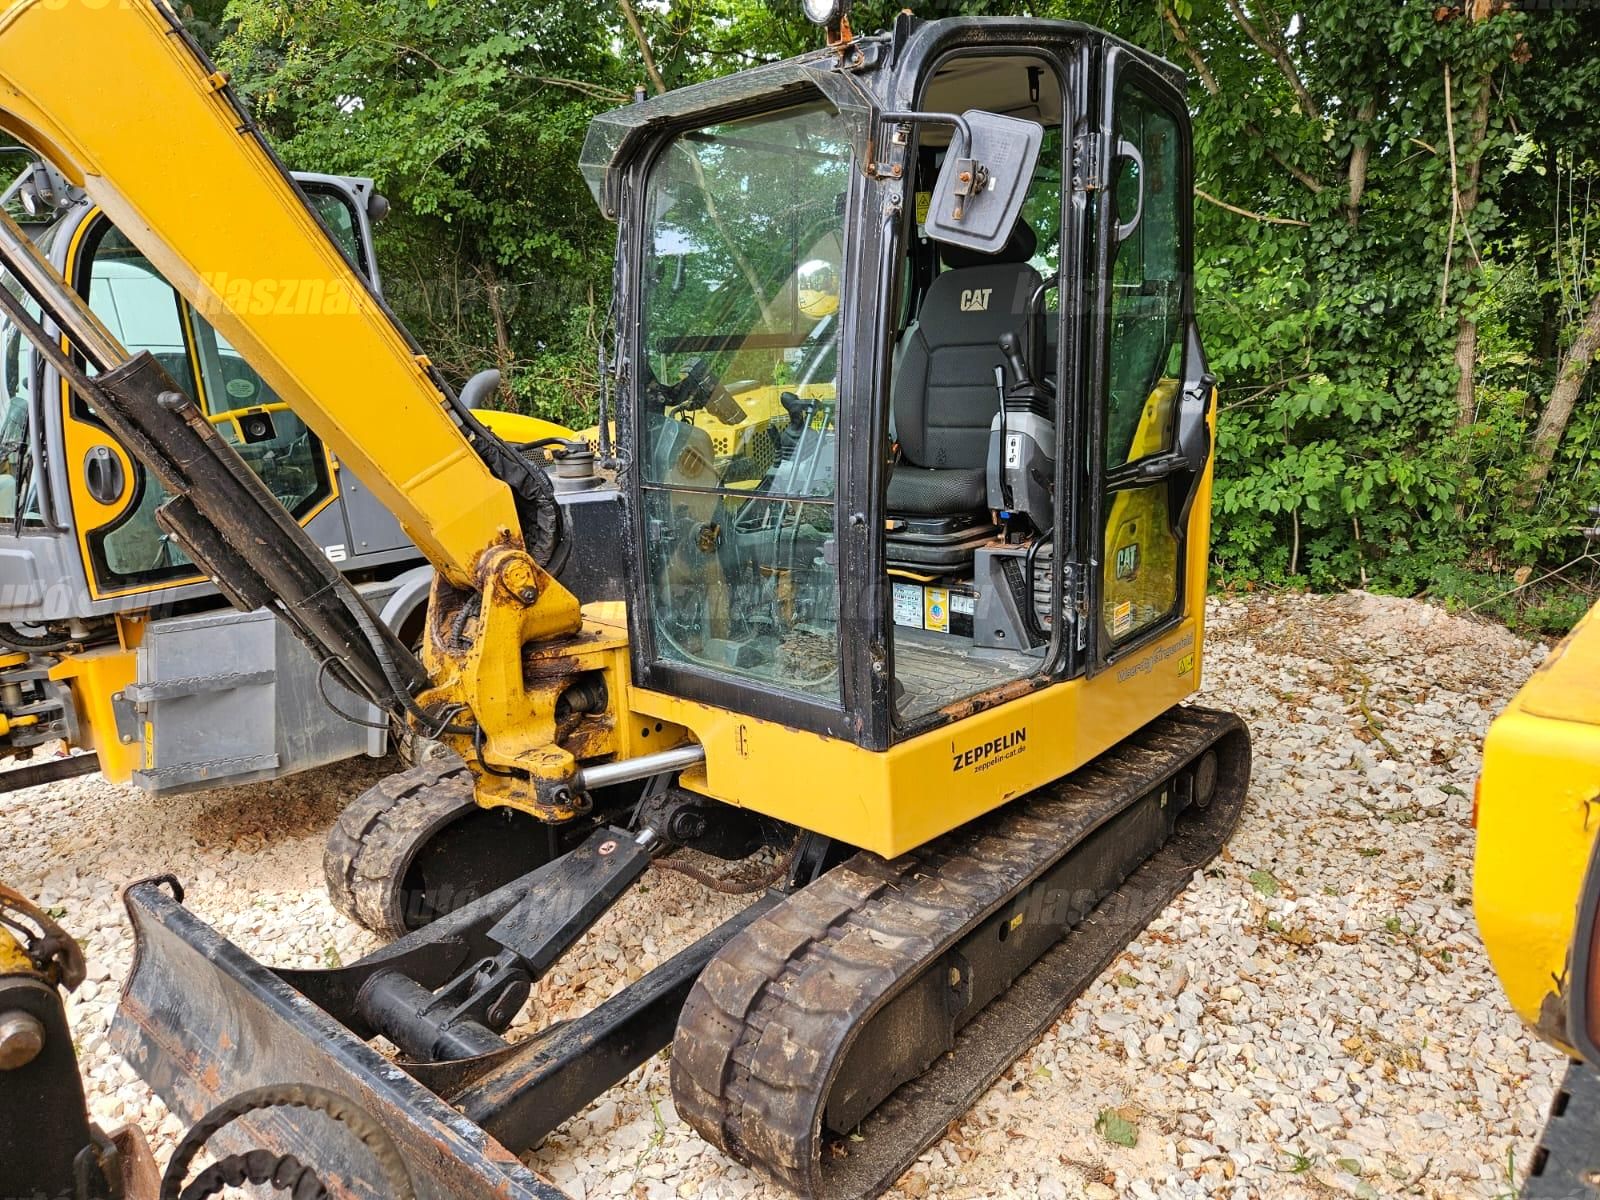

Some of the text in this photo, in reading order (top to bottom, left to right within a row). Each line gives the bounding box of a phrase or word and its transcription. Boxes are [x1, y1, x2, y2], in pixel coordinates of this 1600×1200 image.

[960, 287, 993, 312] CAT
[1116, 544, 1138, 579] CAT
[952, 727, 1027, 773] ZEPPELIN
[974, 745, 1027, 774] zeppelin-cat.de
